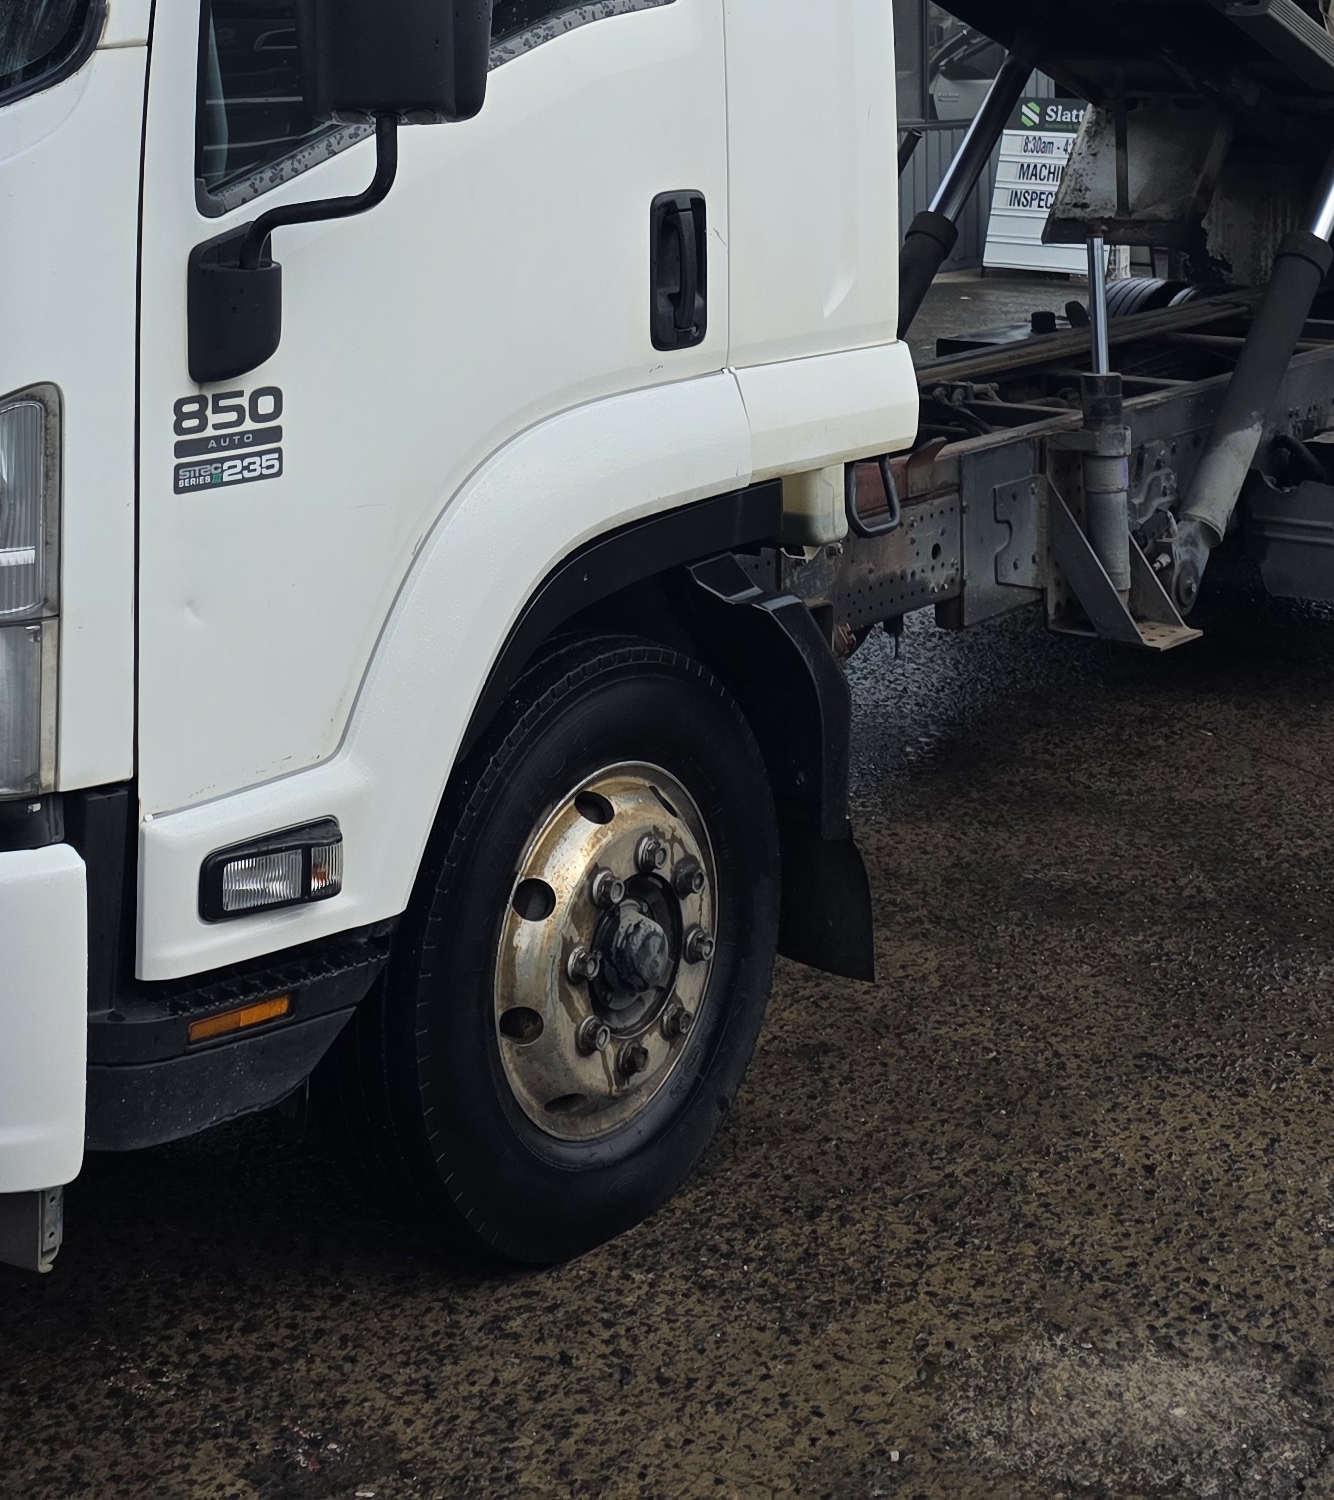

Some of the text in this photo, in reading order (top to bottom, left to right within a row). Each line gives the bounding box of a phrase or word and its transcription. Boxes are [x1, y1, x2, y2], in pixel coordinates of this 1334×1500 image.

[1023, 135, 1055, 155] 8:30am
[173, 386, 284, 437] 850
[208, 433, 253, 449] AUTO
[222, 453, 280, 482] 235
[178, 475, 211, 488] SERIES
